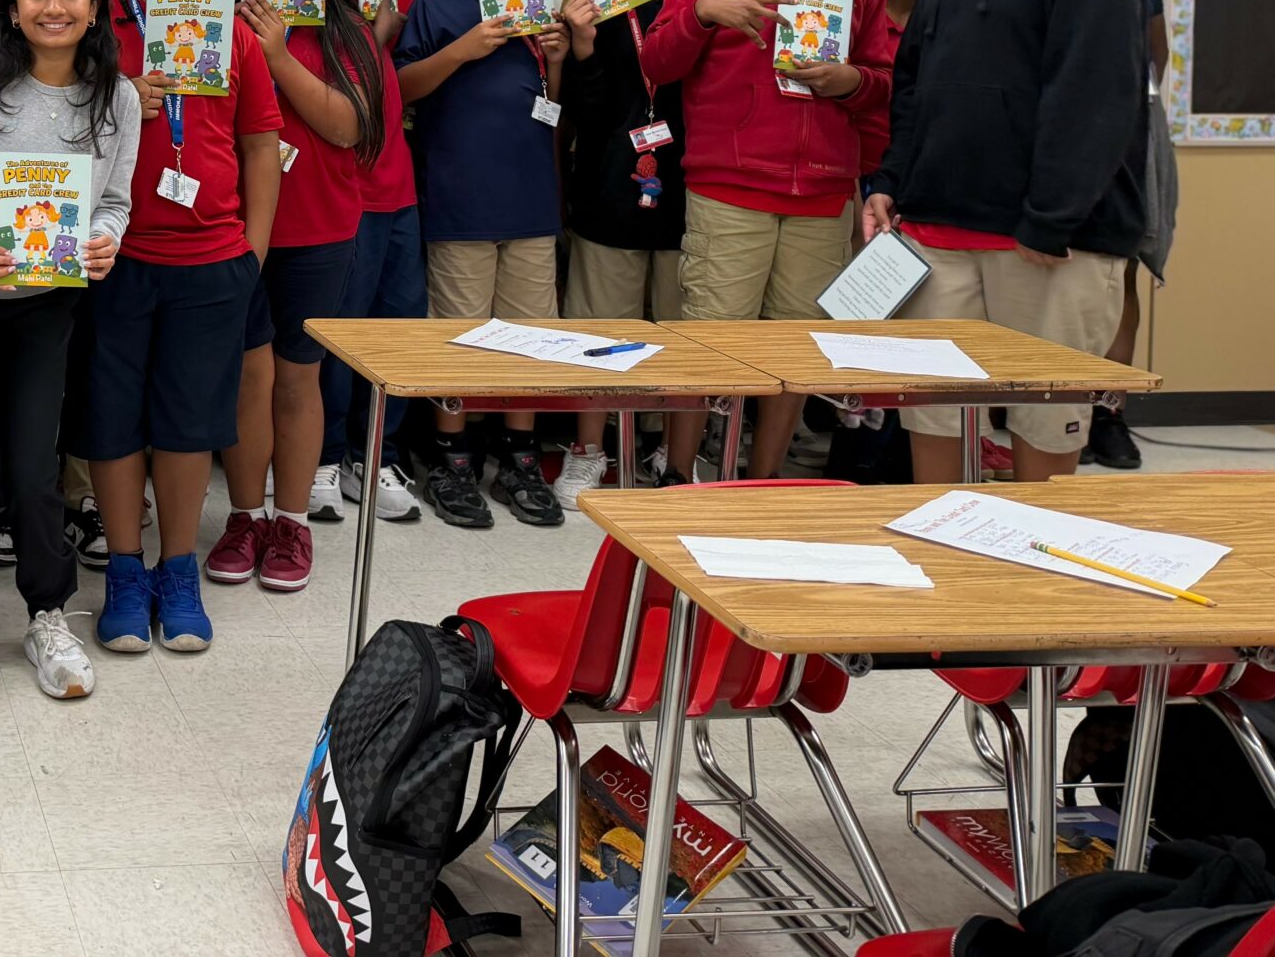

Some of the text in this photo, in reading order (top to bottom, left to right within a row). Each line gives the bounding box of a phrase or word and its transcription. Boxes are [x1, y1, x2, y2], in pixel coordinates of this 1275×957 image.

[150, 8, 223, 18] CREDIT CARD CREW
[3, 167, 71, 184] PENNY
[28, 188, 53, 197] CARD
[53, 190, 80, 199] CREW
